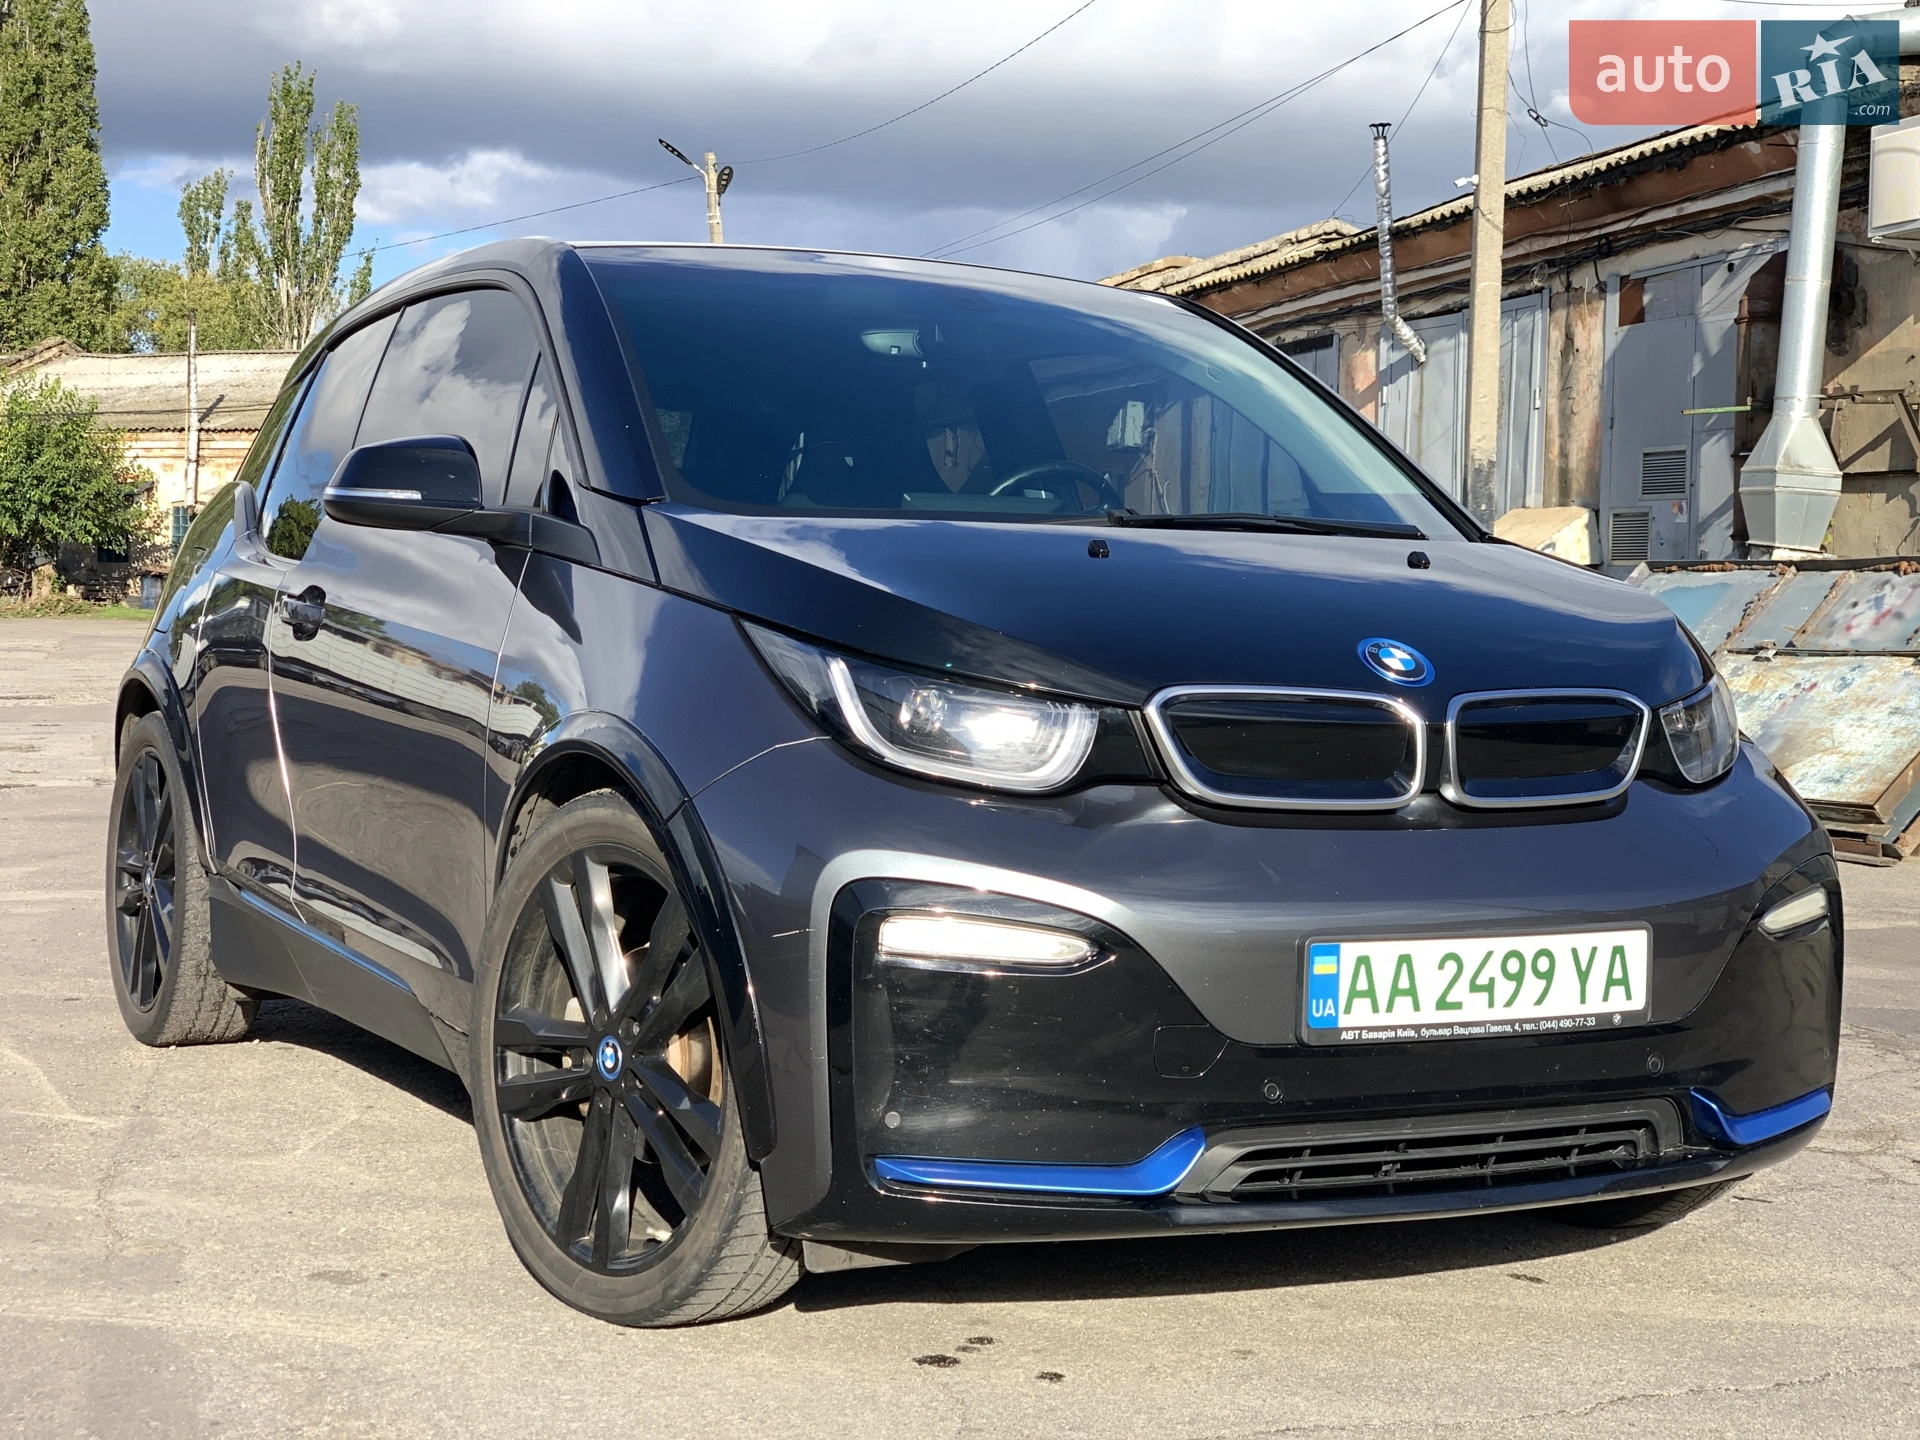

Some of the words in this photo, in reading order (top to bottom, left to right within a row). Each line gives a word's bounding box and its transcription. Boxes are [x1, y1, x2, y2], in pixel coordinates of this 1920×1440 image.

[1343, 954, 1421, 1014] AA
[1435, 948, 1556, 1010] 2499
[1571, 945, 1632, 1004] YA
[1312, 998, 1336, 1017] UA
[1421, 1027, 1453, 1037] бульвар
[1454, 1024, 1485, 1035] Вацлава
[1539, 1019, 1558, 1031] (044)
[1559, 1017, 1596, 1028] 490-77-33
